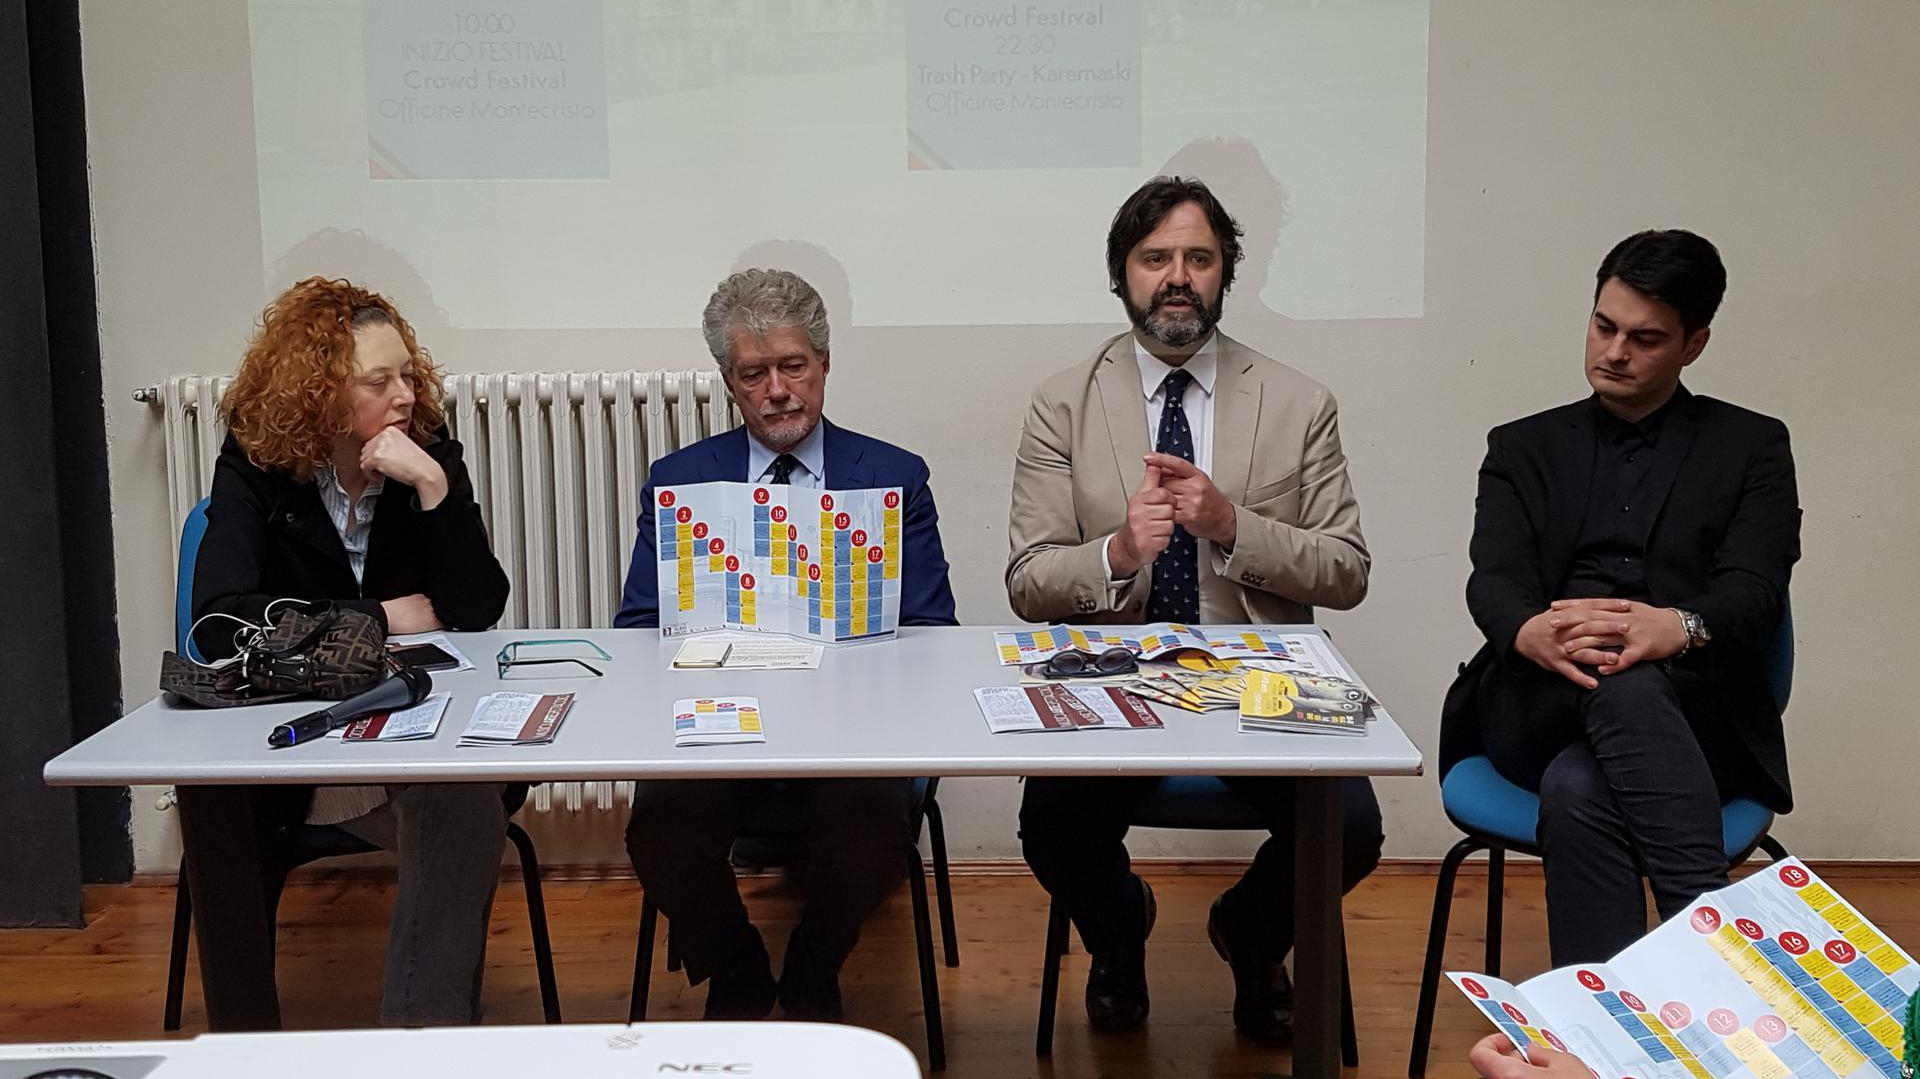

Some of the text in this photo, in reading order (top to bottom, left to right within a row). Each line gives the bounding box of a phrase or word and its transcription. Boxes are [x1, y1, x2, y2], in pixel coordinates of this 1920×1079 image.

[944, 2, 1104, 28] Crowd Festival
[401, 41, 566, 62] INIZIO FESTIVAL
[403, 67, 566, 90] Crowd Festival
[916, 61, 965, 85] Trash
[970, 64, 1016, 88] Party
[1033, 58, 1132, 83] Karemaski
[926, 91, 1124, 117] Officine Montecristo
[377, 97, 596, 124] Officine Montecristo
[759, 491, 764, 499] 9
[824, 497, 831, 505] 14
[888, 495, 896, 503] 18
[775, 509, 784, 518] 10
[839, 516, 847, 524] 15
[856, 533, 864, 541] 16
[872, 549, 880, 557] 17
[811, 567, 818, 575] 13
[745, 577, 750, 585] 8
[1785, 869, 1801, 880] 18
[1695, 911, 1713, 926] 14
[1741, 922, 1756, 935] 15
[1784, 936, 1802, 948] 16
[1830, 943, 1847, 956] 17
[1585, 975, 1594, 985] 9
[1469, 982, 1479, 992] 1
[1625, 994, 1639, 1005] 10
[1666, 1007, 1682, 1021] 11
[1714, 1013, 1731, 1028] 12
[1762, 1021, 1778, 1034] 13
[658, 1062, 753, 1075] NEC
